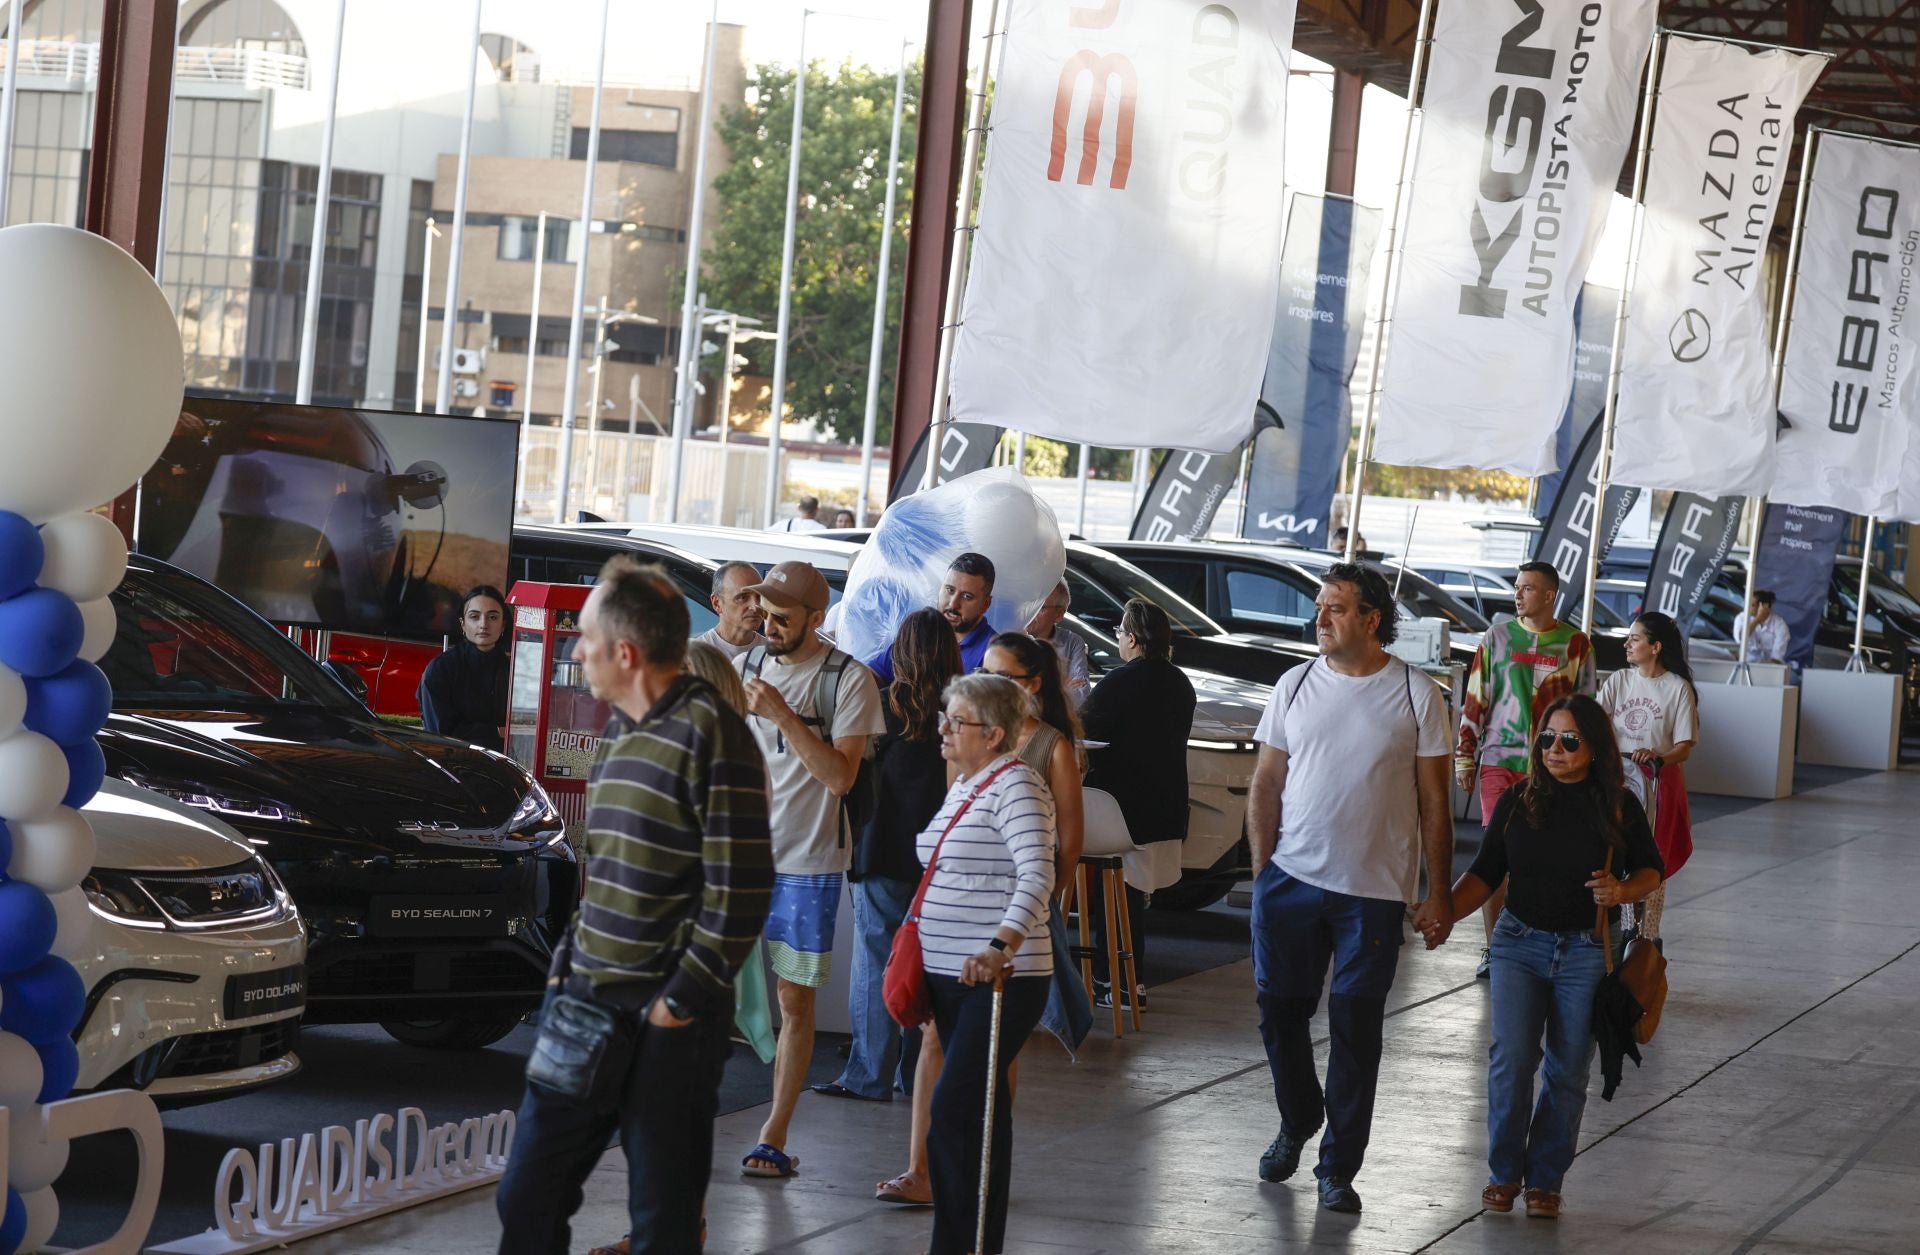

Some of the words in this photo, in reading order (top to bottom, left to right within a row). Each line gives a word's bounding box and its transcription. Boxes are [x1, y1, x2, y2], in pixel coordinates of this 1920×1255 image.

[1521, 114, 1573, 318] AUTOPISTA
[1561, 2, 1602, 105] MOTO
[1691, 92, 1751, 286] MAZDA
[1723, 96, 1782, 291] Almenar
[1288, 303, 1334, 323] inspires
[1828, 185, 1900, 435] EBRO
[1887, 229, 1920, 339] Automoción
[1878, 342, 1902, 410] Marcos
[1598, 488, 1635, 567] Automoción
[1688, 567, 1714, 605] Marcos
[1709, 501, 1740, 569] Automoción
[1779, 536, 1814, 551] inspires
[1783, 519, 1804, 533] that
[1785, 505, 1835, 524] Movement
[391, 908, 420, 919] BYD
[423, 908, 481, 919] SEALION
[481, 908, 493, 918] 7
[243, 988, 264, 1002] BYD
[215, 1112, 394, 1240] QUADIS
[398, 1106, 518, 1190] Dream
